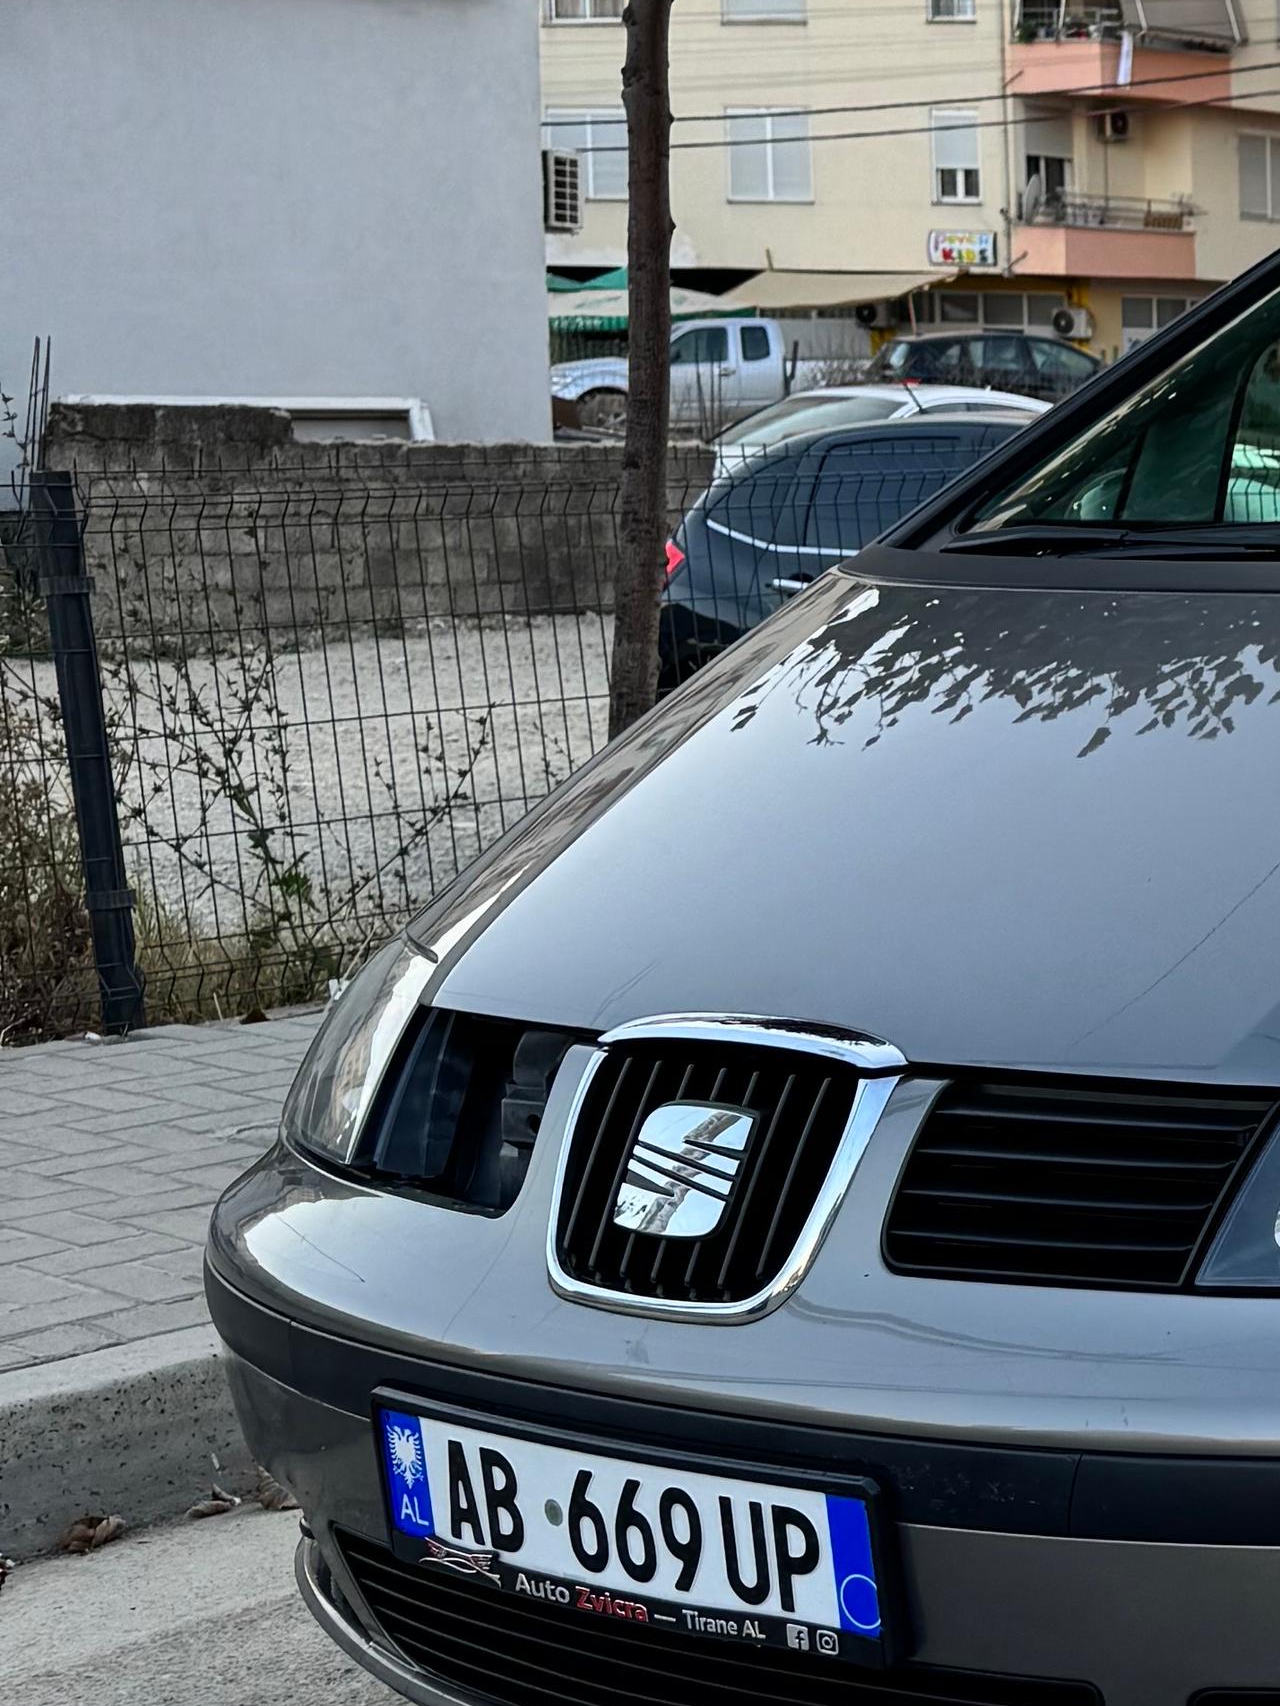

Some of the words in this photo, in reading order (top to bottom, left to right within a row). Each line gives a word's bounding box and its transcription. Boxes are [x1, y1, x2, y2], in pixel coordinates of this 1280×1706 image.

[400, 1493, 430, 1526] AL
[447, 1439, 525, 1553] AB
[568, 1469, 703, 1592] 669
[718, 1495, 820, 1613] UP
[515, 1572, 571, 1604] Auto
[574, 1585, 649, 1623] Zvicra
[681, 1608, 739, 1636] Tirane
[741, 1619, 767, 1639] AL
